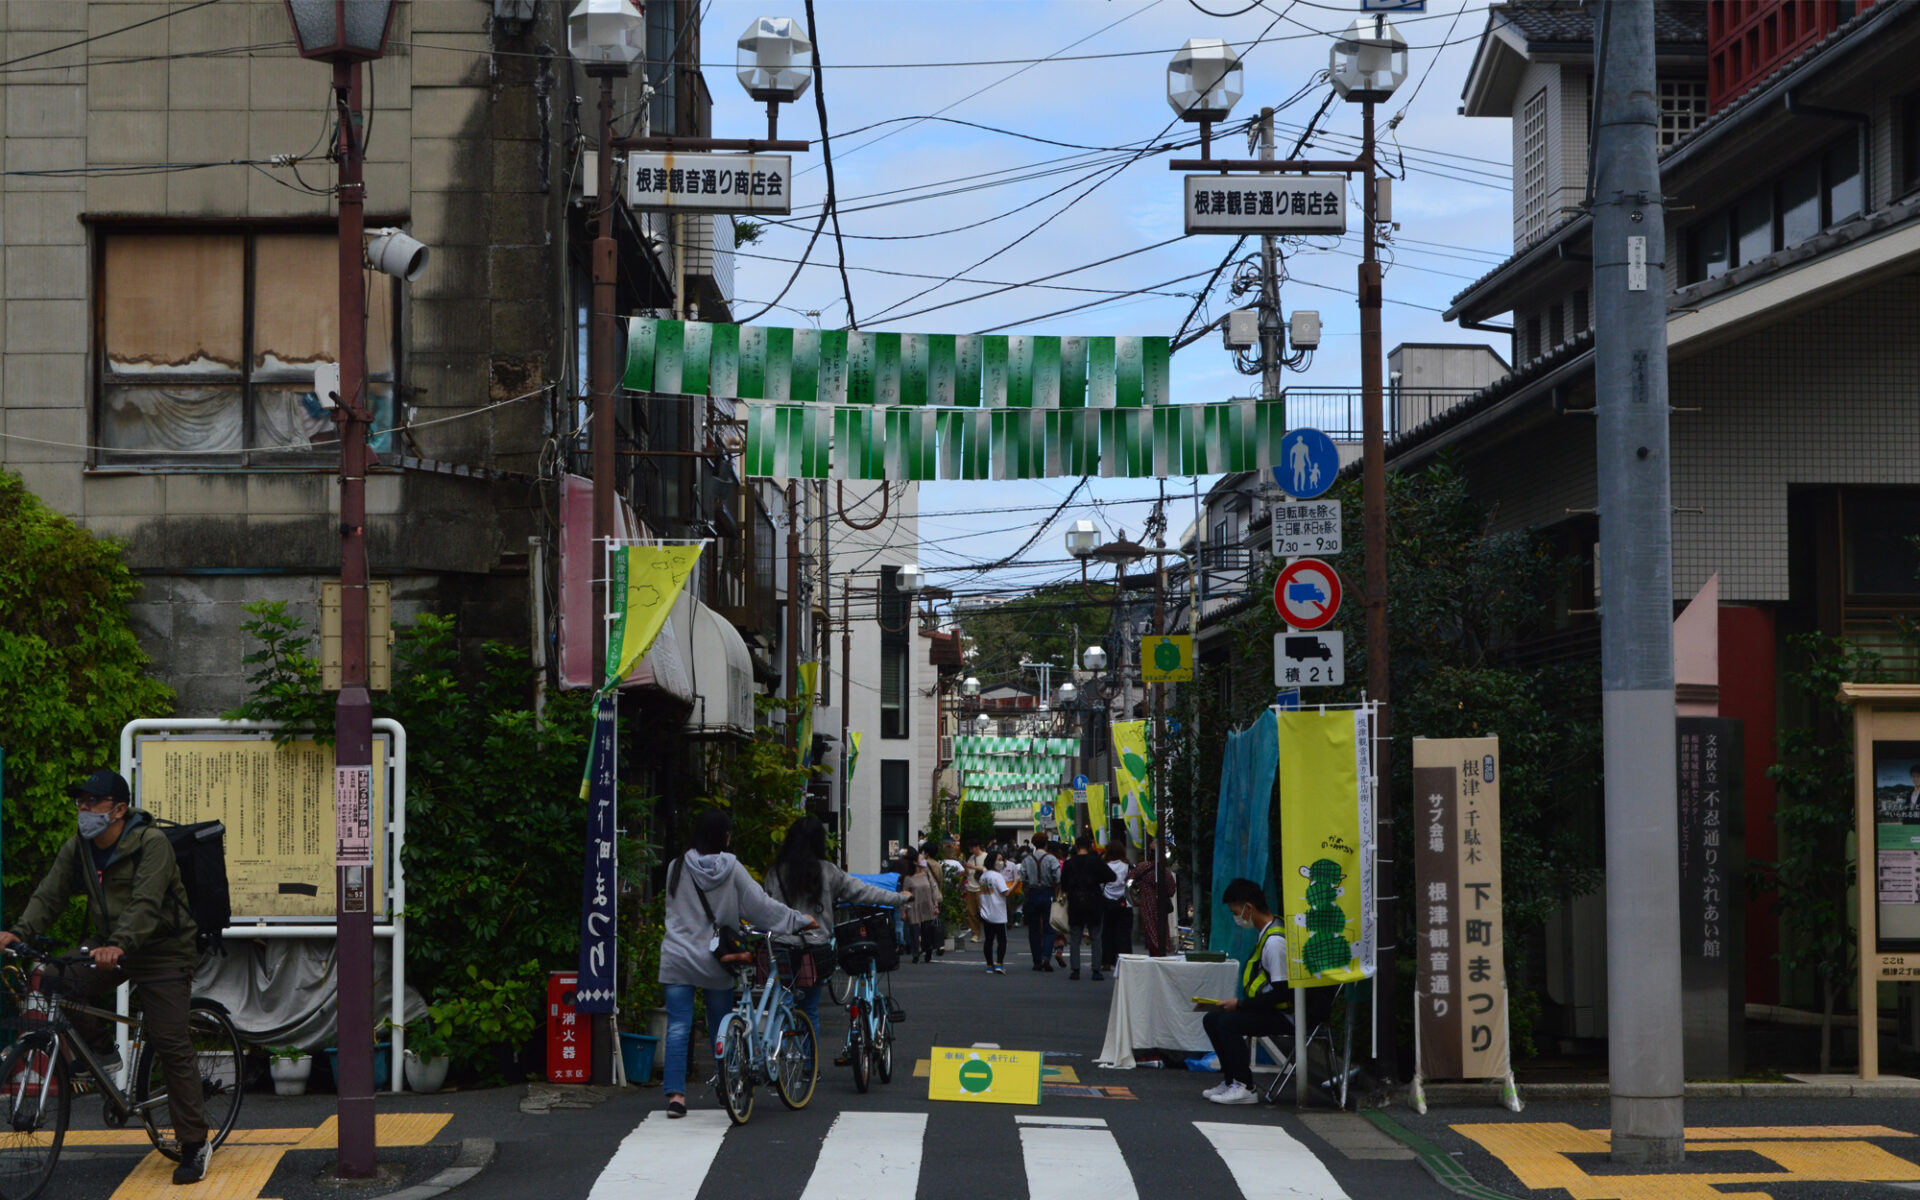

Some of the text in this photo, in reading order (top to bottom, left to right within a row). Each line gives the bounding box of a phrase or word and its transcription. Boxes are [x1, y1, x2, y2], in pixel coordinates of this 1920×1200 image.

[636, 168, 782, 196] 根津観音通り商店会
[1194, 190, 1338, 215] 根津観音通り商店会
[1276, 504, 1336, 519] 自転車を除く
[1703, 733, 1720, 957] 文京区立 不忍通りふれあい館
[1428, 793, 1450, 1017] サブ会場 根津観音通り
[1463, 759, 1494, 1052] 根津・千駄木 下町まつり
[562, 1012, 576, 1059] 消火器
[555, 1070, 583, 1078] 文京区
